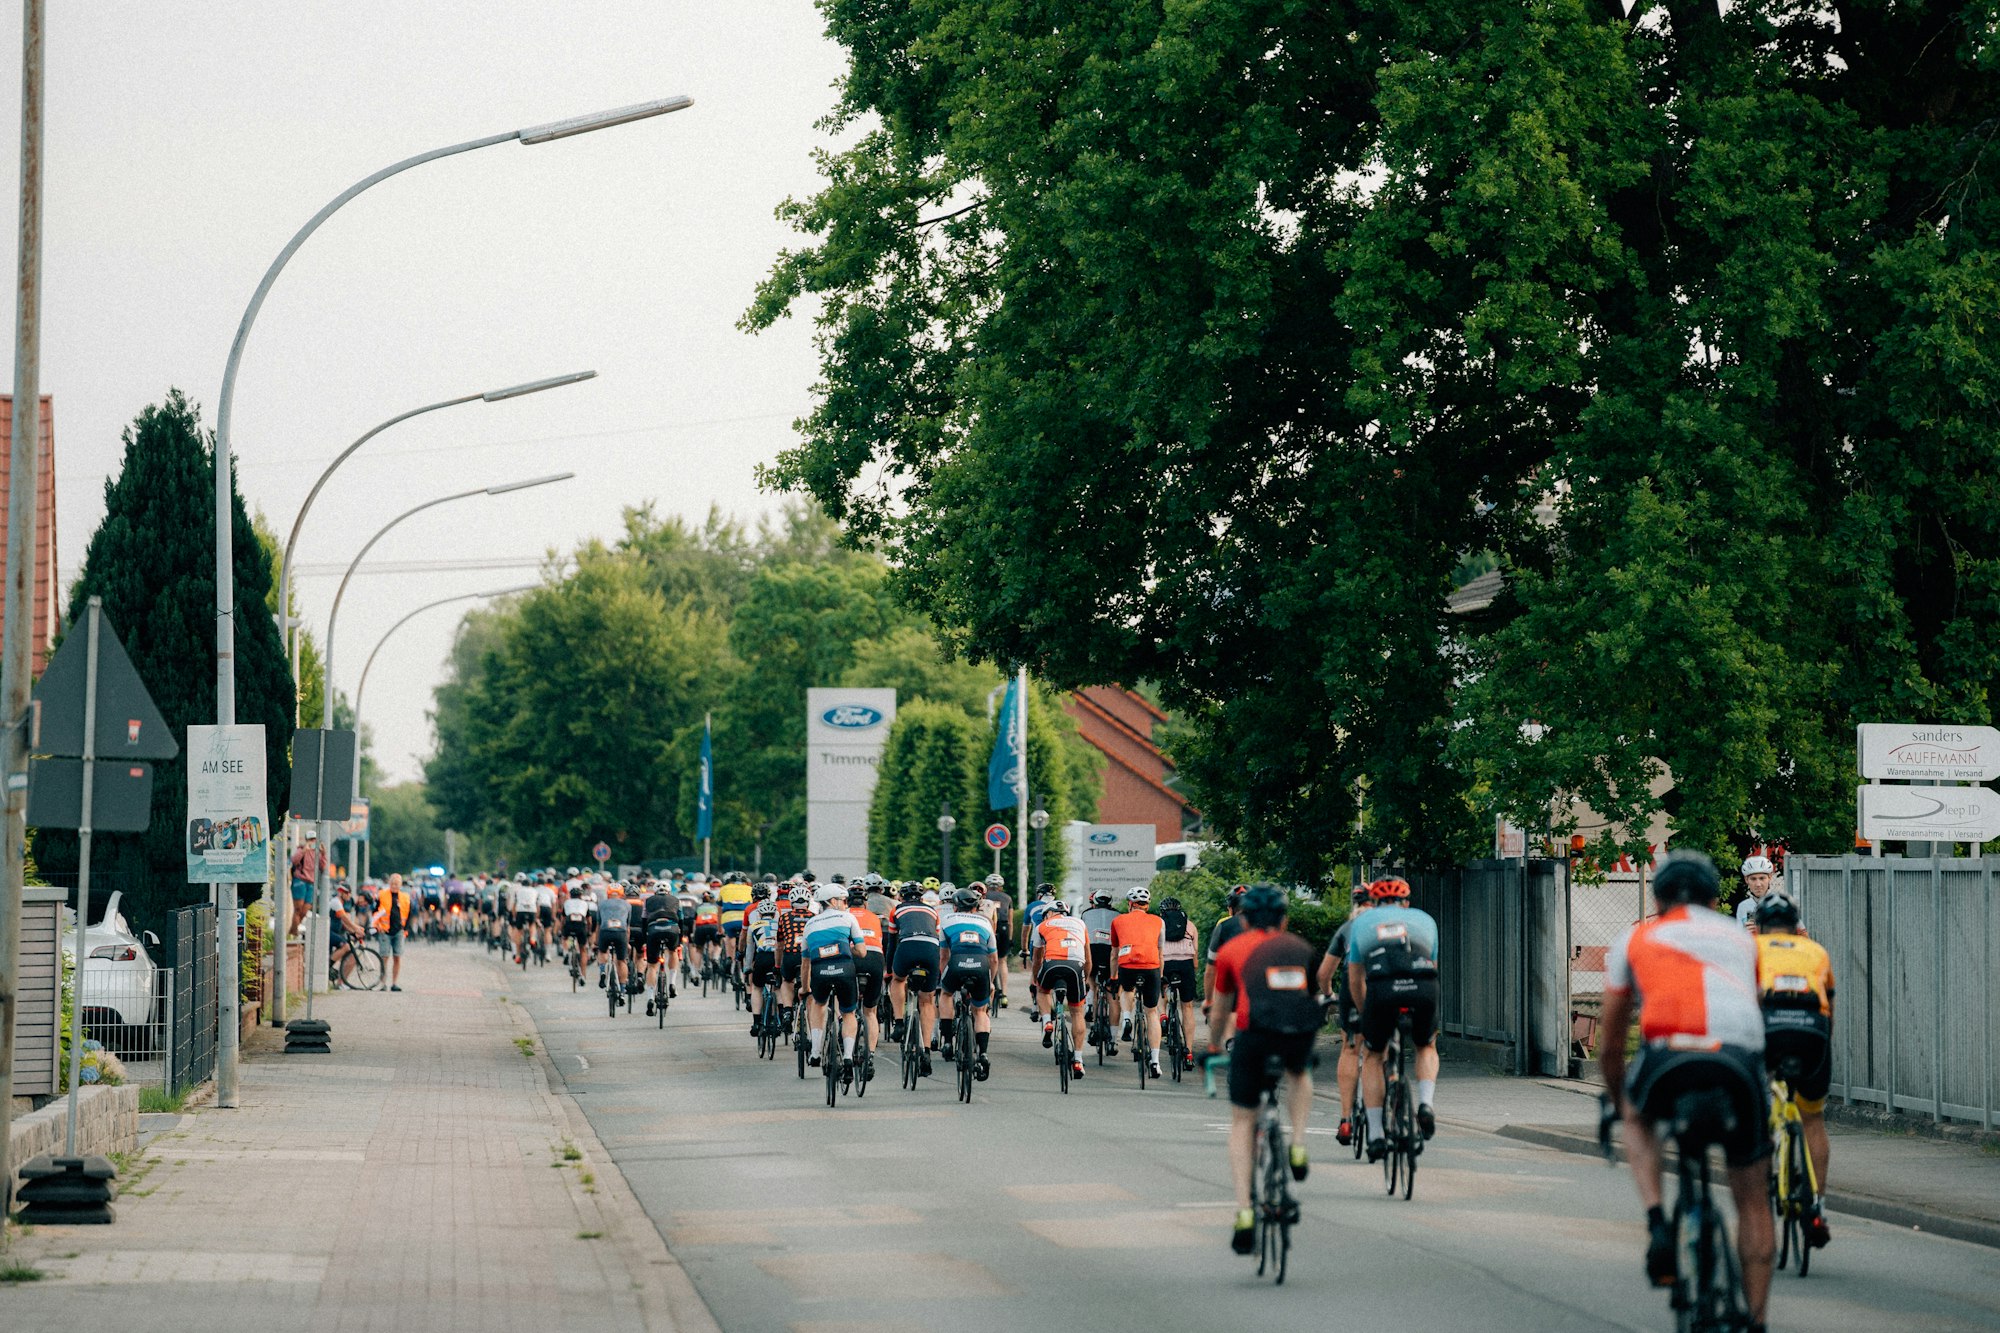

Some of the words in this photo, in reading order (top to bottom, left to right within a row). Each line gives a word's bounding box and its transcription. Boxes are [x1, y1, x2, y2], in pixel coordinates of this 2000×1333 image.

[1912, 729, 1962, 742] sanders
[1897, 752, 1977, 765] KAUFFMANN
[202, 761, 218, 773] AM
[222, 760, 244, 773] SEE
[1887, 768, 1944, 777] Warenannahme
[1954, 769, 1983, 777] Versand
[1968, 804, 1981, 816] ID
[1887, 829, 1944, 838] Warenannahme
[1954, 830, 1983, 839] Versand
[1088, 848, 1139, 857] Timmer
